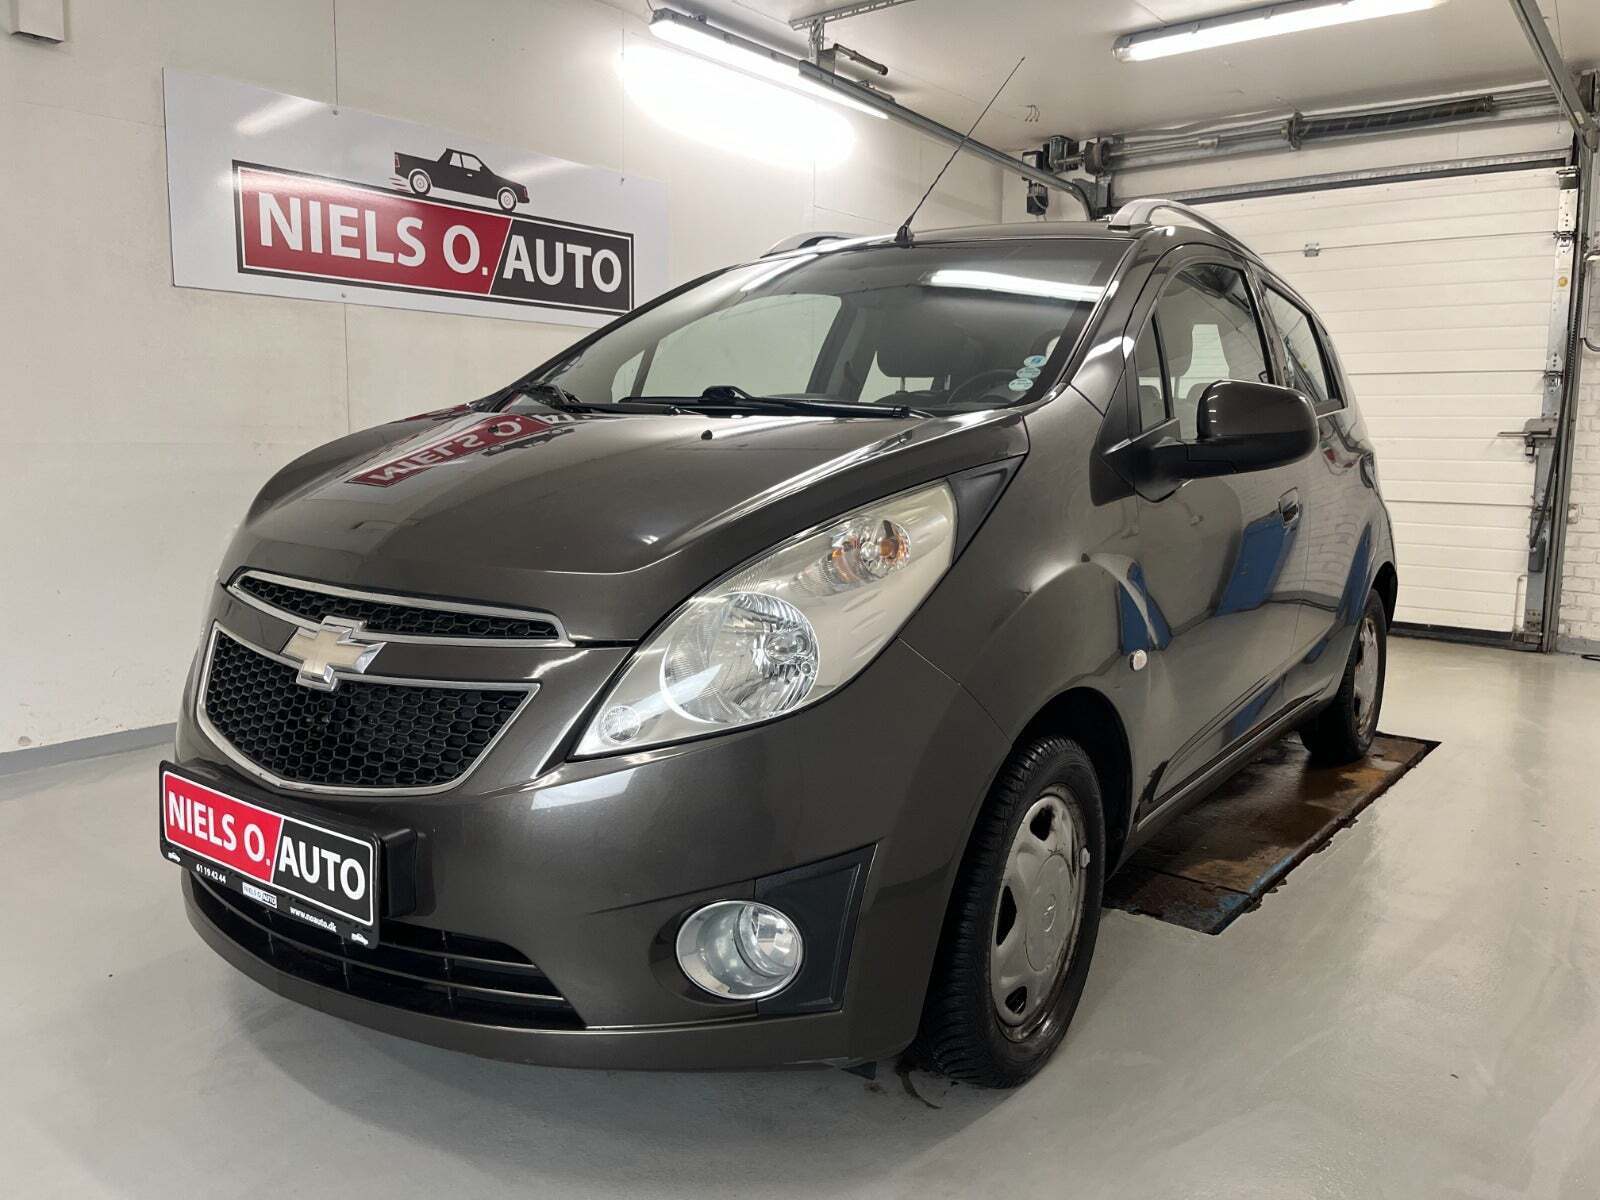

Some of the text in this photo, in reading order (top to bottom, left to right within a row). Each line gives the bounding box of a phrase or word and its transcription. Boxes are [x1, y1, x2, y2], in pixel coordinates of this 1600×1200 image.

[258, 191, 623, 293] NIELS O. AUTO
[168, 791, 366, 901] NIELS O. AUTO
